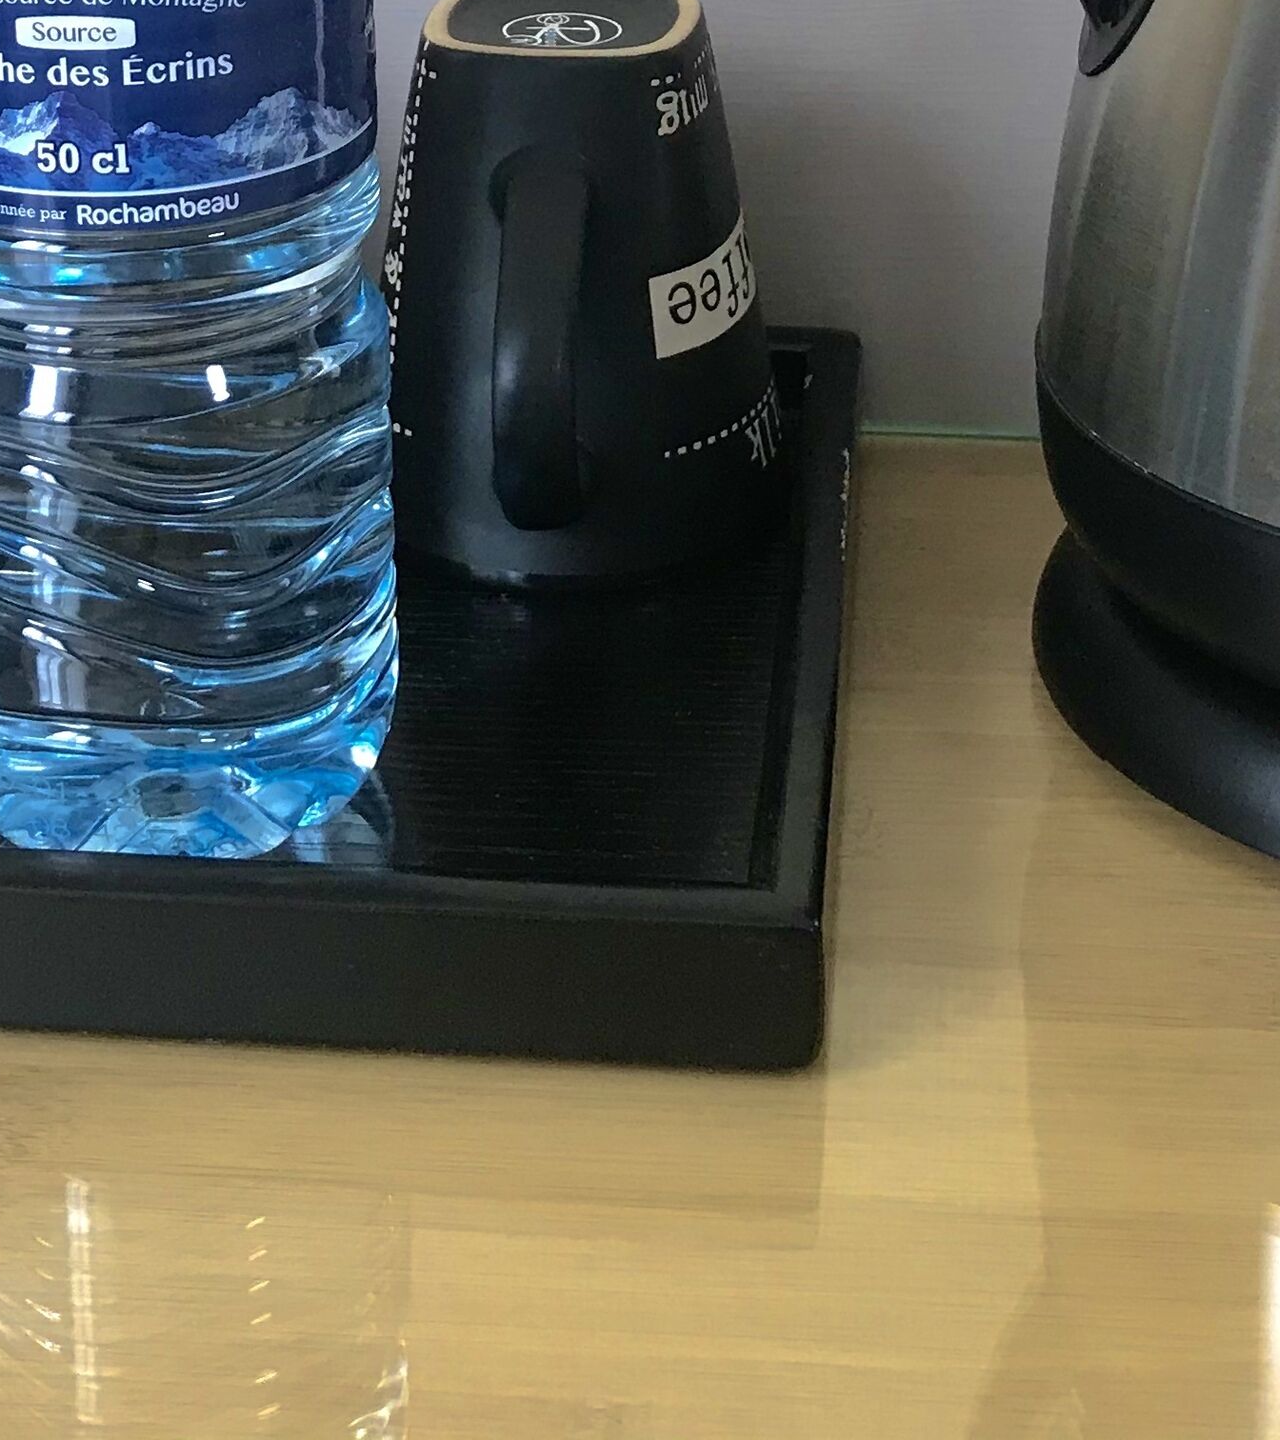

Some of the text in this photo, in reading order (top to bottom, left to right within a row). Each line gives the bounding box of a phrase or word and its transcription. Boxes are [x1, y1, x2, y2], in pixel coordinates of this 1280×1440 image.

[31, 21, 118, 43] Source
[46, 57, 110, 87] des
[122, 49, 234, 87] Écrins
[656, 73, 709, 136] mug
[36, 142, 131, 174] 50 cl
[39, 208, 68, 222] par
[76, 192, 241, 226] Rochambeau
